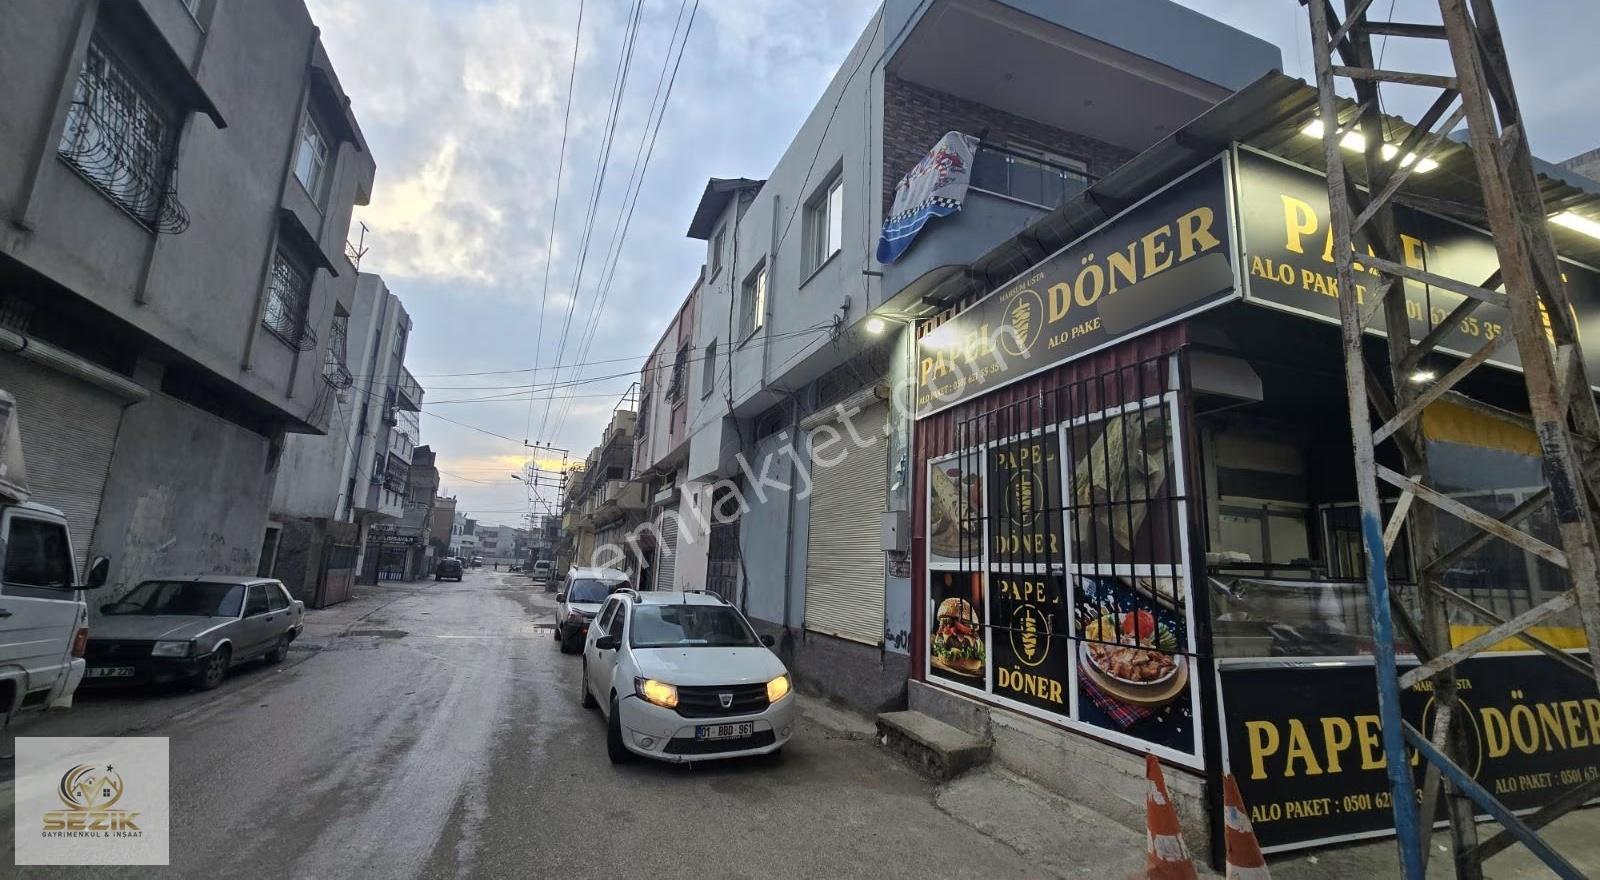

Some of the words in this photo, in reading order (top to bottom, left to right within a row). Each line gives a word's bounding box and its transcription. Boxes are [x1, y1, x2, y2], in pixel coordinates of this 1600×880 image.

[1047, 206, 1221, 324] DÖNER
[1251, 255, 1295, 285] ALO
[1301, 268, 1367, 304] PAKT
[1047, 331, 1069, 350] ALO
[1071, 316, 1101, 339] PAKE
[996, 530, 1058, 554] DÖNER
[998, 665, 1063, 704] DÖNER
[702, 727, 710, 737] 01
[719, 725, 733, 737] BBD
[739, 722, 752, 735] 961
[1245, 715, 1418, 779] PAPE
[1495, 777, 1517, 794] ALO
[1519, 773, 1552, 790] PAKET
[1251, 803, 1281, 823] ALO
[1285, 798, 1331, 819] PAKET
[1343, 793, 1372, 812] 0501
